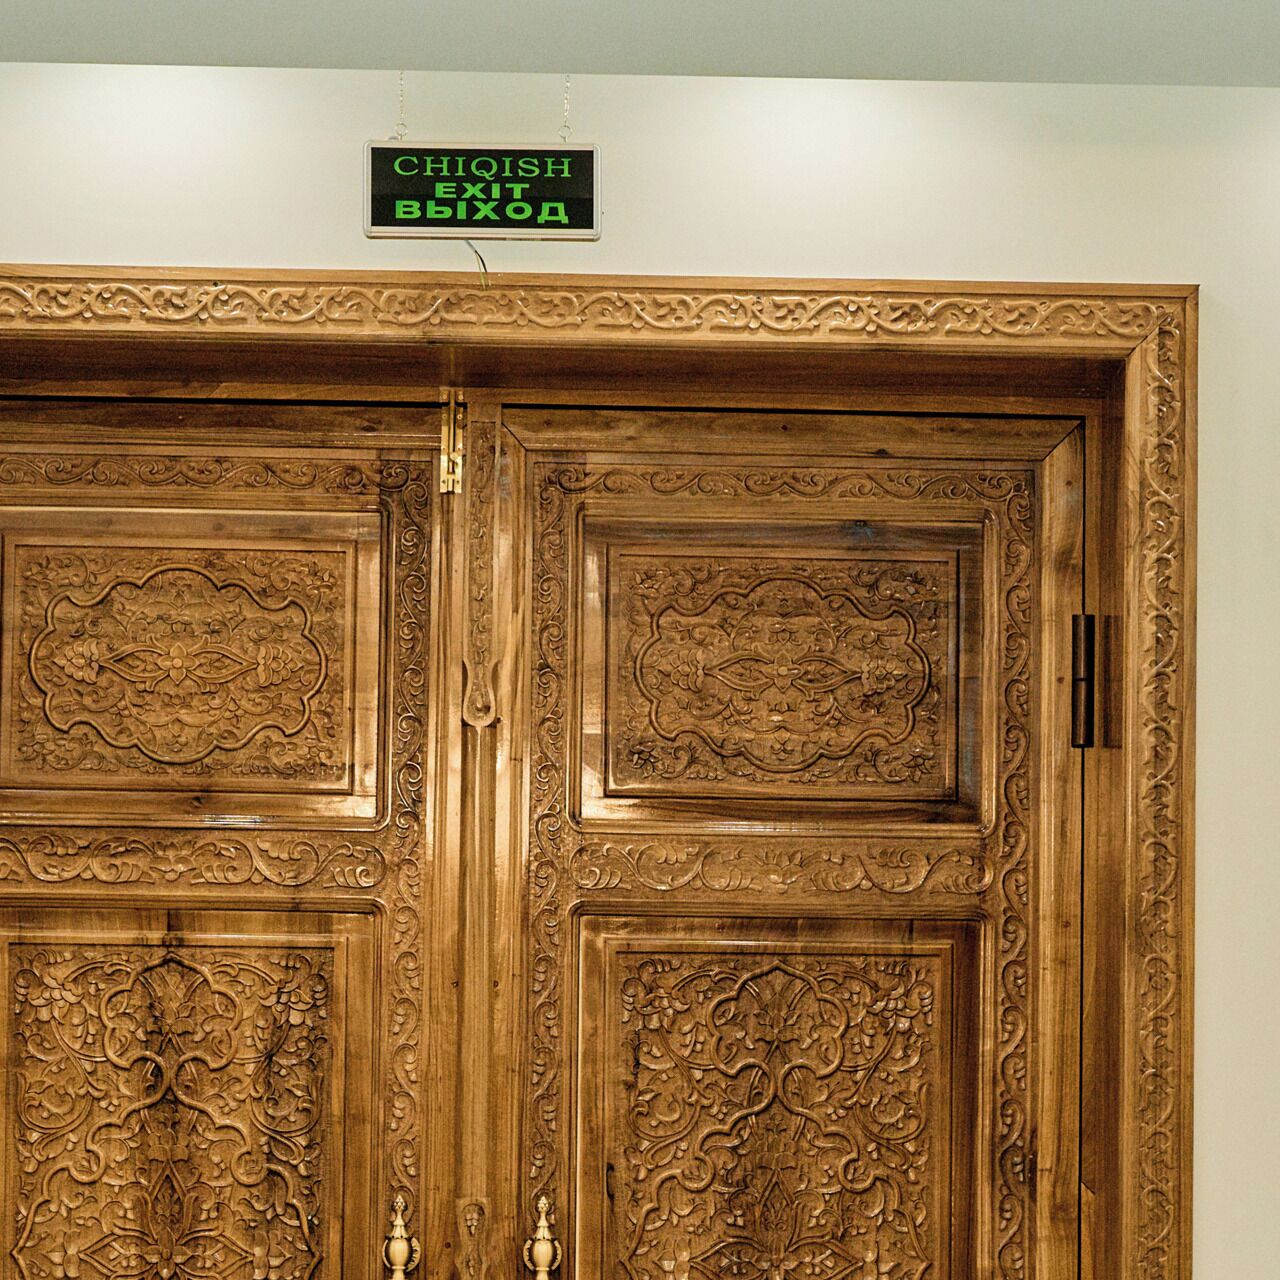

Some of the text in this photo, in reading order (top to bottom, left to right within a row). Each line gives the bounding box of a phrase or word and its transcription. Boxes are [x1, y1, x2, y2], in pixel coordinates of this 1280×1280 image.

[393, 156, 572, 180] CHIQISH
[435, 182, 530, 199] EXIT
[395, 200, 569, 224] ВЫХОД
